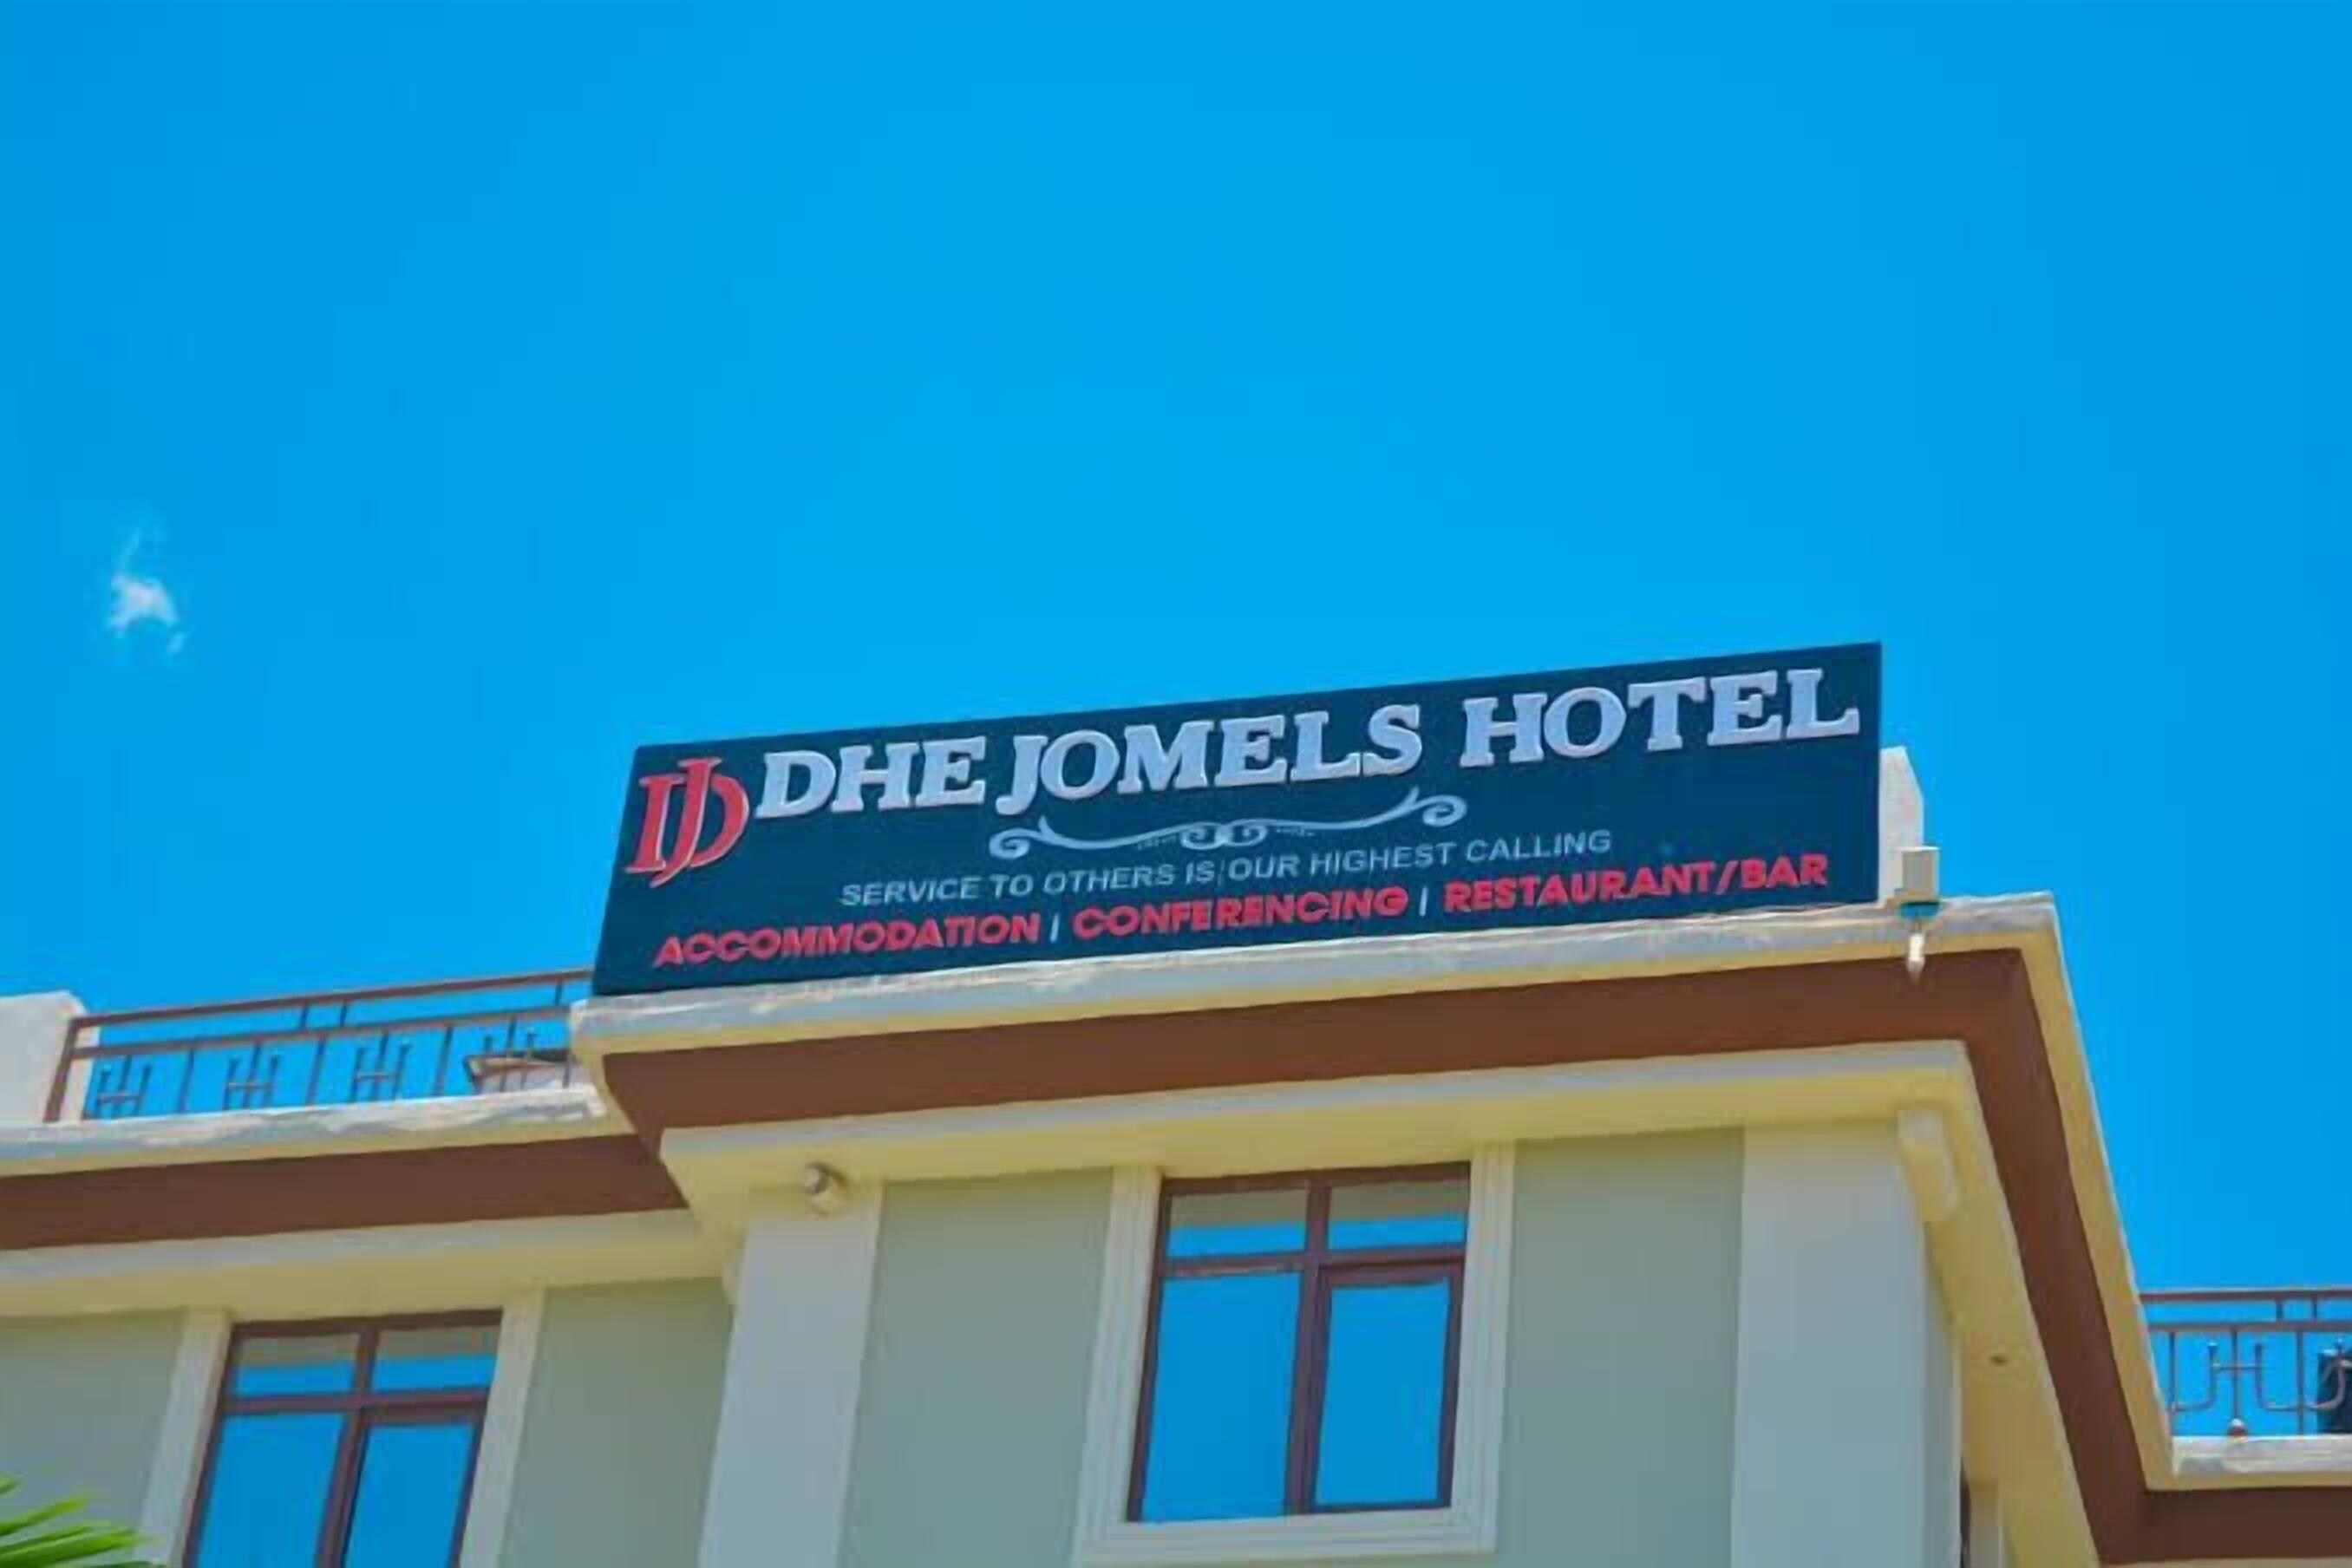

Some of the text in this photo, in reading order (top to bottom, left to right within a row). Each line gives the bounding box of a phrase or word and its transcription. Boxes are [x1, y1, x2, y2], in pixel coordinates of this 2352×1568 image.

[755, 669, 1860, 820] DHE JOMELS HOTEL
[652, 913, 1040, 968] ACCOMMODATION
[1072, 885, 1409, 939] CONFERENCING
[1444, 853, 1830, 913] RESTAURANT/BAR
[840, 830, 1612, 907] SERVICE TO OTHERS IS OUR HIGHEST CALLING
